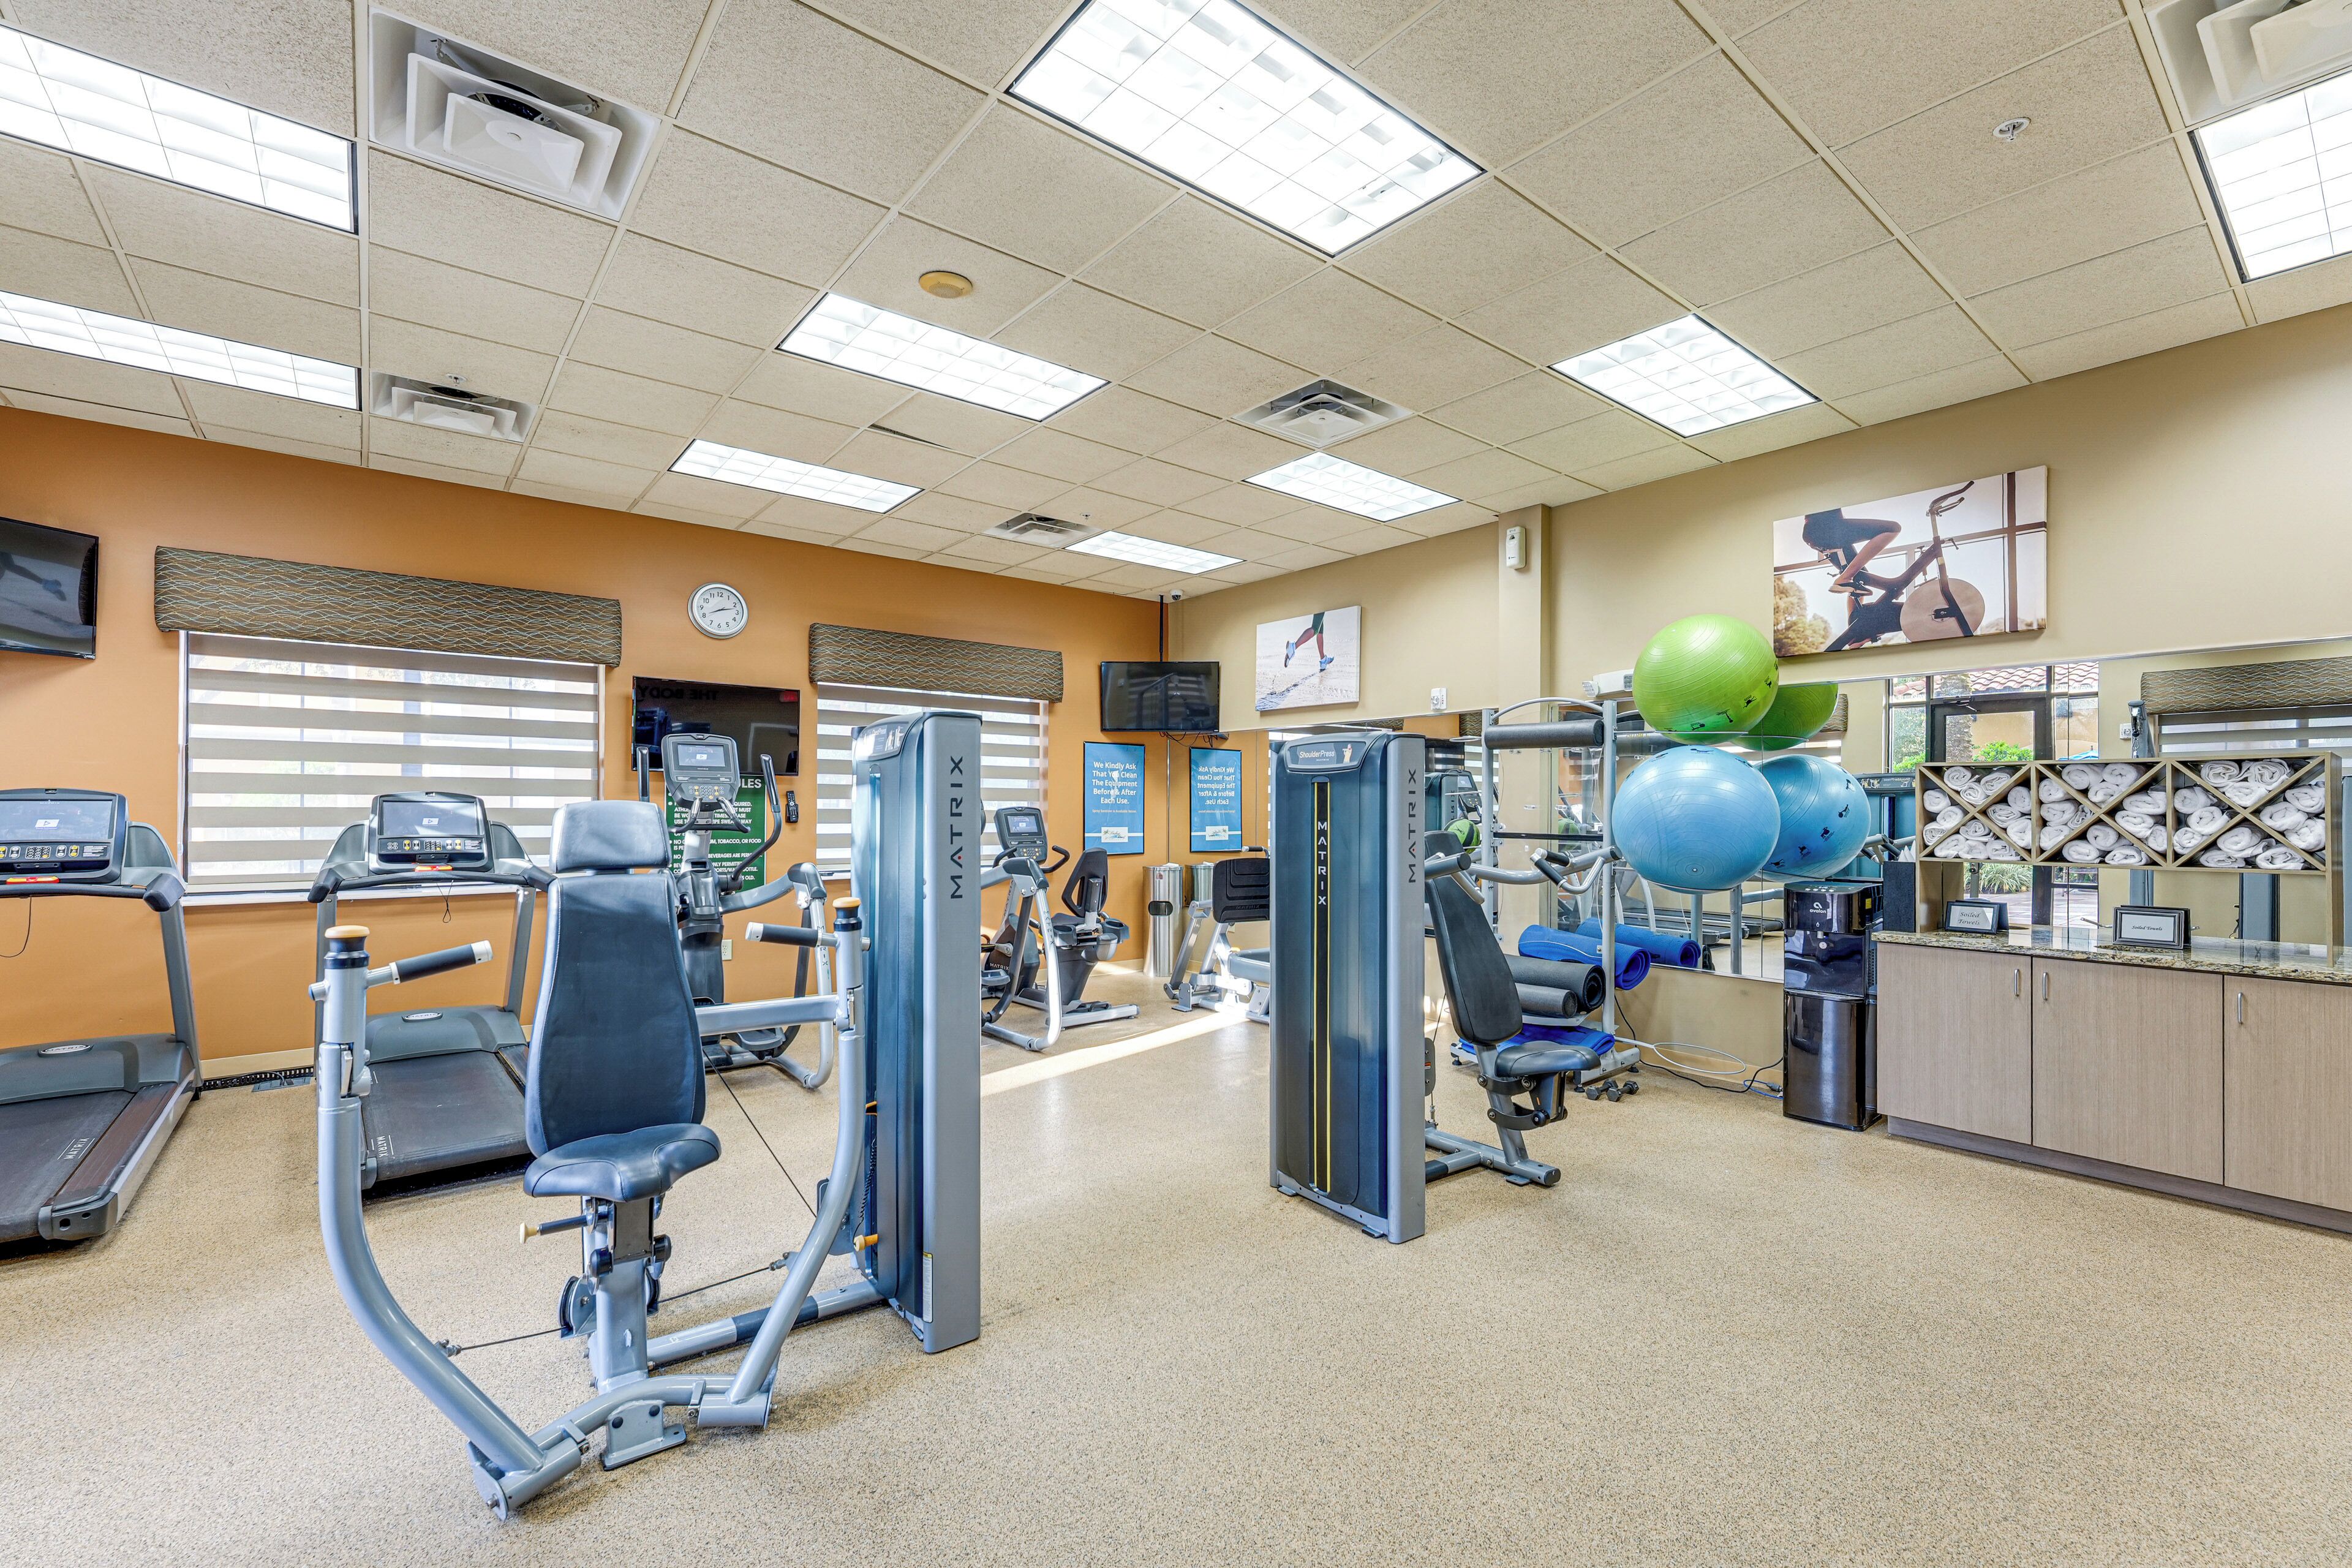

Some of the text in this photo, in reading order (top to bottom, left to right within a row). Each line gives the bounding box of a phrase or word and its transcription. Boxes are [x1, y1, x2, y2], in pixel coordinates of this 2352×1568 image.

[1105, 762, 1124, 771] Kindly
[739, 778, 762, 788] LES
[950, 755, 963, 899] MATRIX
[1317, 821, 1327, 905] MATRIX
[817, 925, 828, 966] MRIX
[990, 962, 1009, 971] MATRIX
[64, 1137, 89, 1159] MATRIX
[376, 1136, 388, 1158] MATRIX
